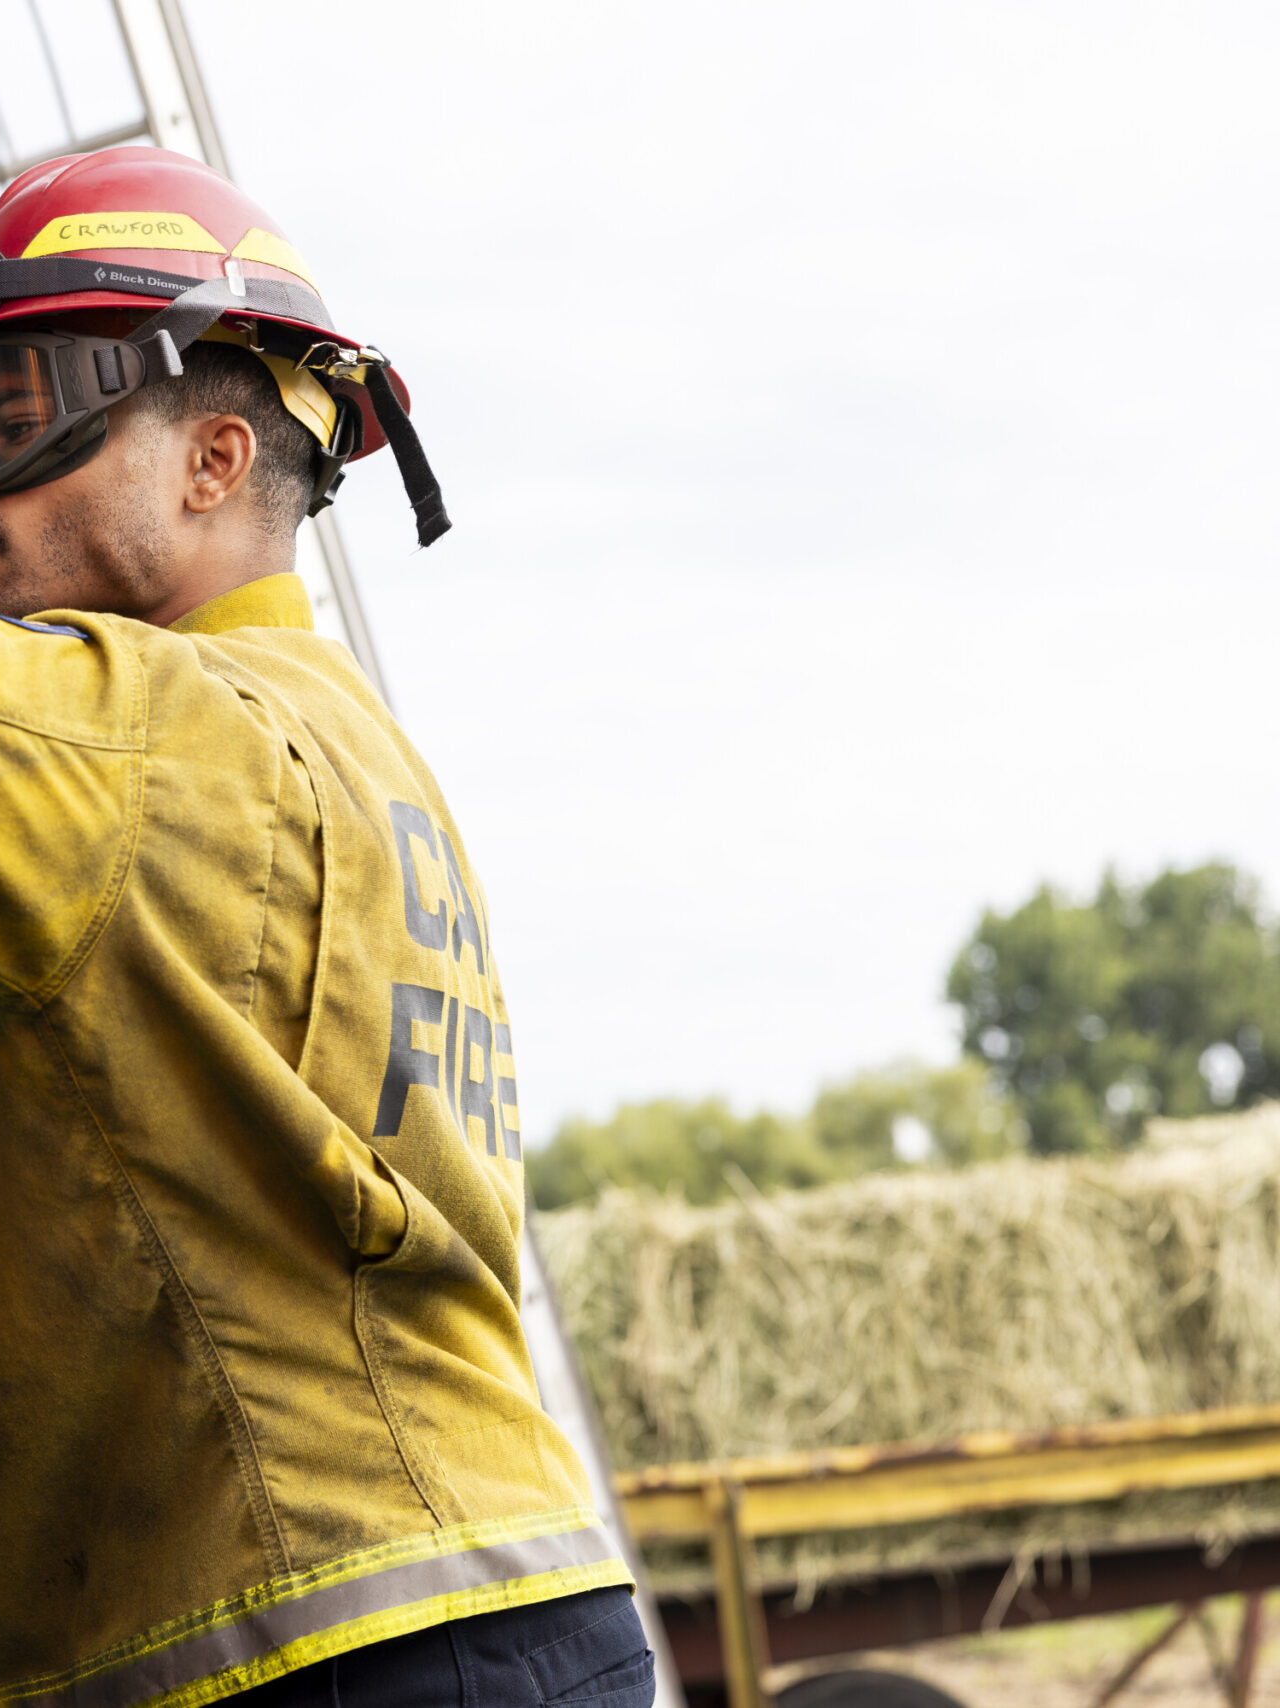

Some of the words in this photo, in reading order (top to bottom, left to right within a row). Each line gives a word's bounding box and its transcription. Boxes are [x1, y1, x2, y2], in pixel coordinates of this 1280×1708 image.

[59, 221, 184, 239] CRAWFORD
[109, 271, 145, 284] Black
[389, 800, 490, 980] CA
[372, 982, 522, 1162] FIRE
